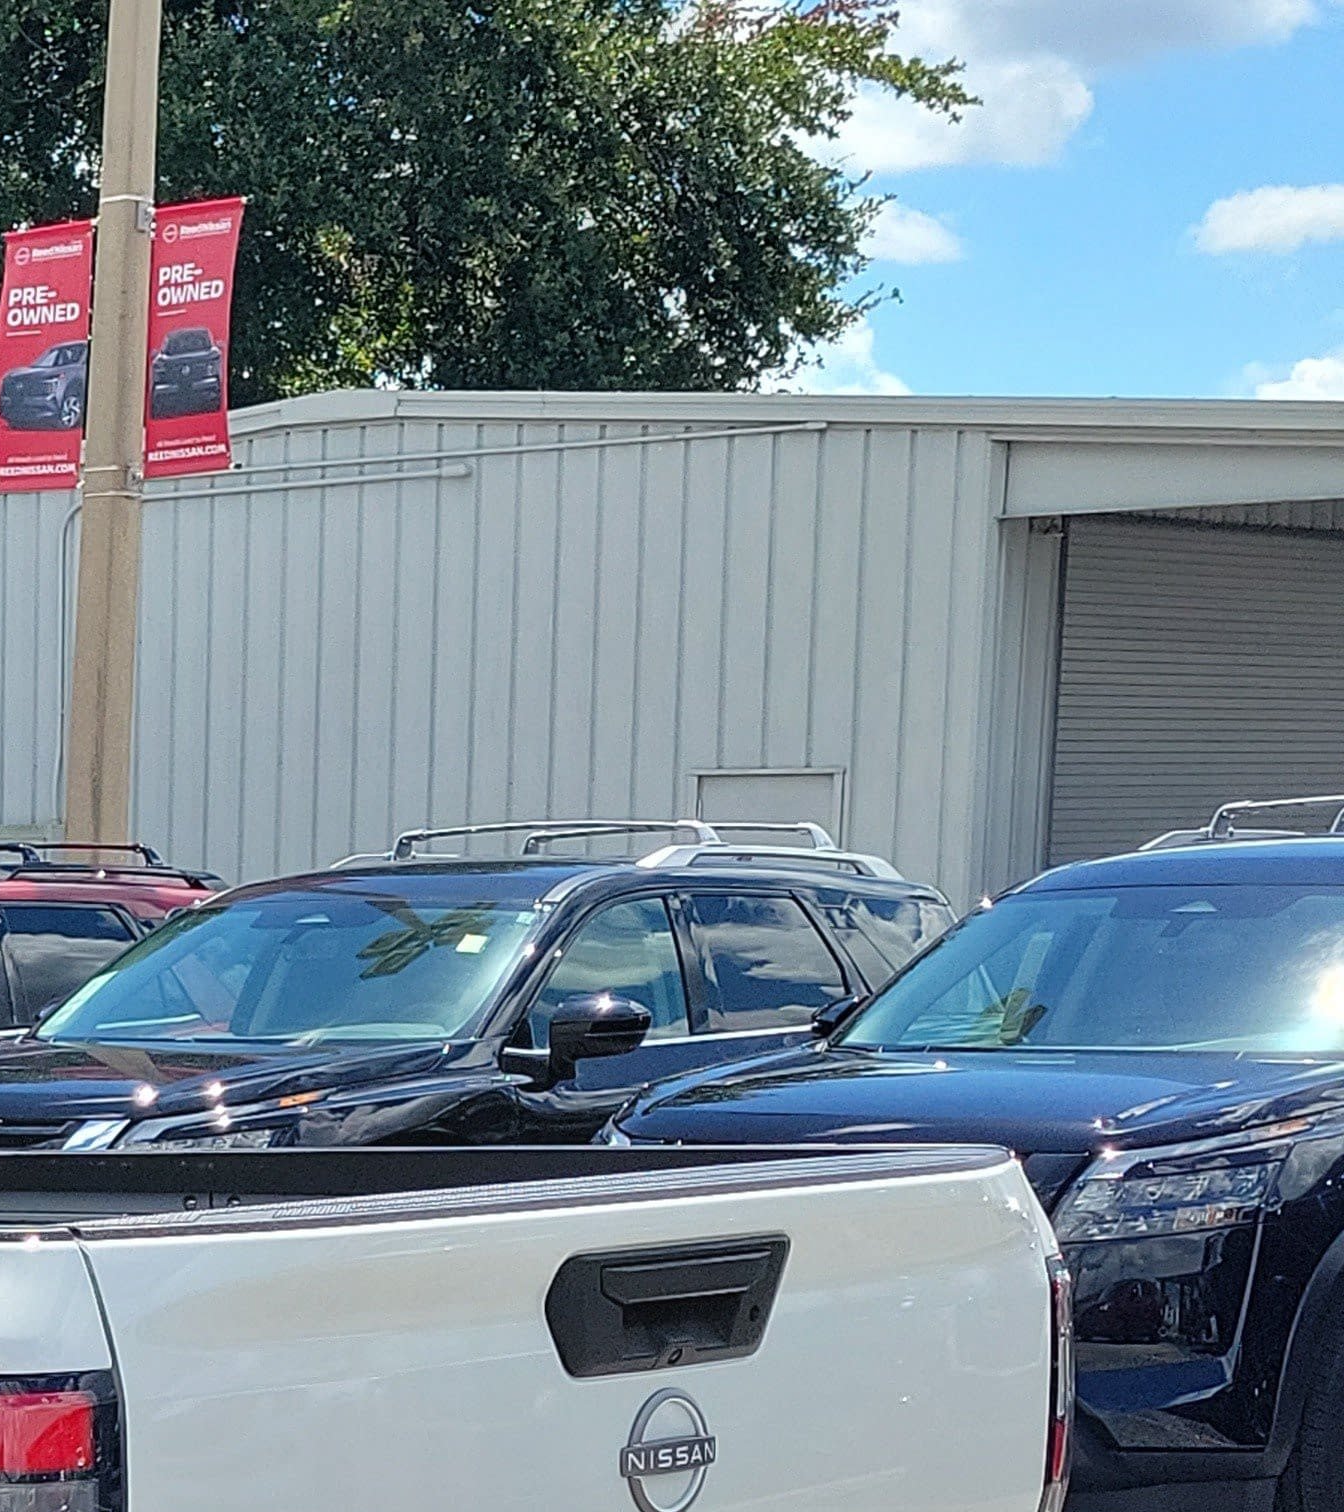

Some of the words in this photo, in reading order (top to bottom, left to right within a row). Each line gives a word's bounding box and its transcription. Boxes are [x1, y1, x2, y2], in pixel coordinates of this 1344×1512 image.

[158, 262, 204, 287] PRE-
[8, 285, 58, 308] PRE-
[156, 279, 225, 307] OWNED
[6, 301, 80, 327] OWNED
[627, 1440, 715, 1472] NISSAN
